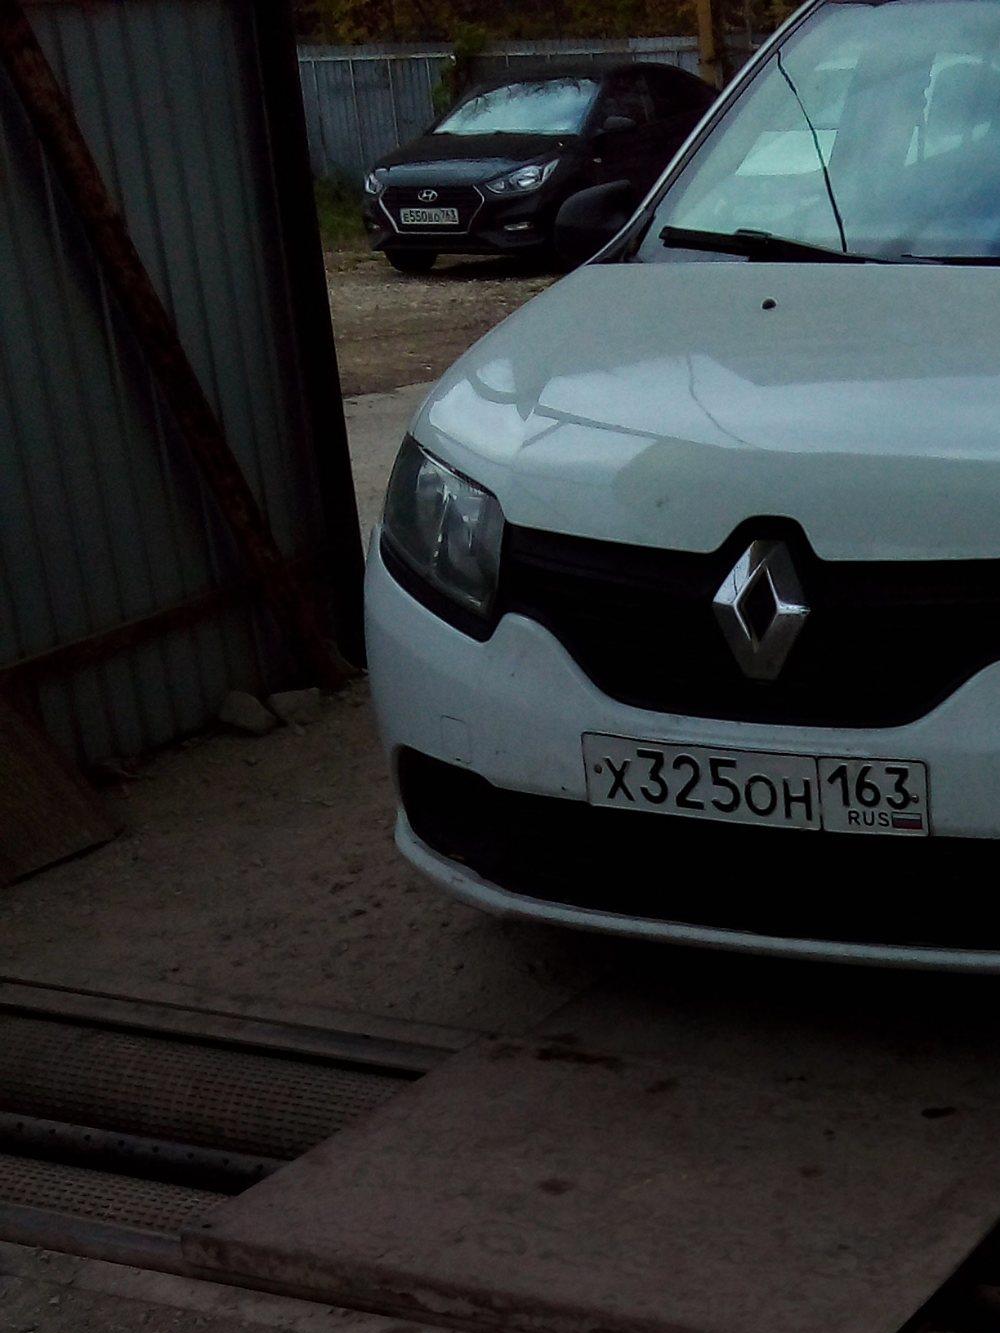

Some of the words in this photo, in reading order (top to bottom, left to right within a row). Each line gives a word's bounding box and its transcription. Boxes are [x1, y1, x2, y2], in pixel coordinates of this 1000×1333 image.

[603, 748, 813, 822] Х325ОН
[826, 764, 911, 810] 163
[847, 810, 890, 828] RUS
